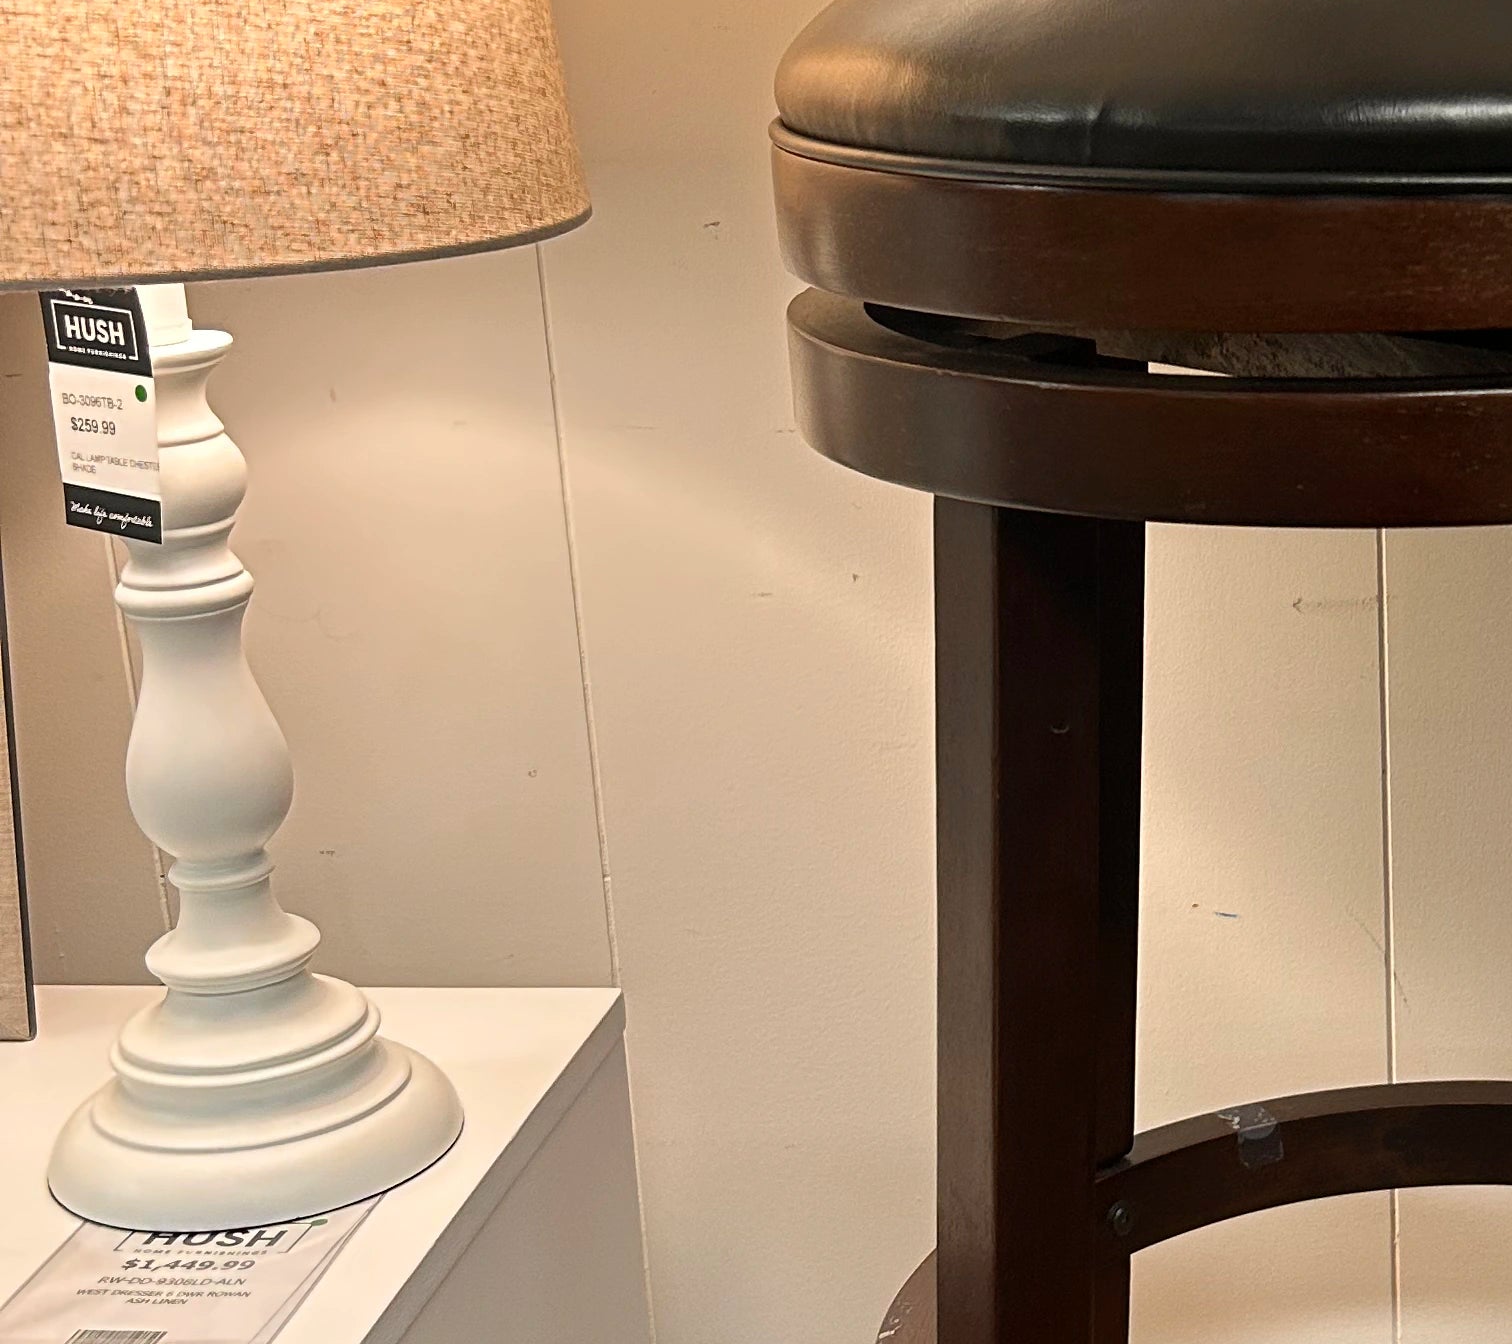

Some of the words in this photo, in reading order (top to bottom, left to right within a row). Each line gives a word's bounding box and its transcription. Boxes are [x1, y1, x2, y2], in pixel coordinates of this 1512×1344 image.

[64, 314, 126, 346] HUSH
[70, 416, 117, 436] $259.99
[122, 1258, 256, 1272] $1,449.99
